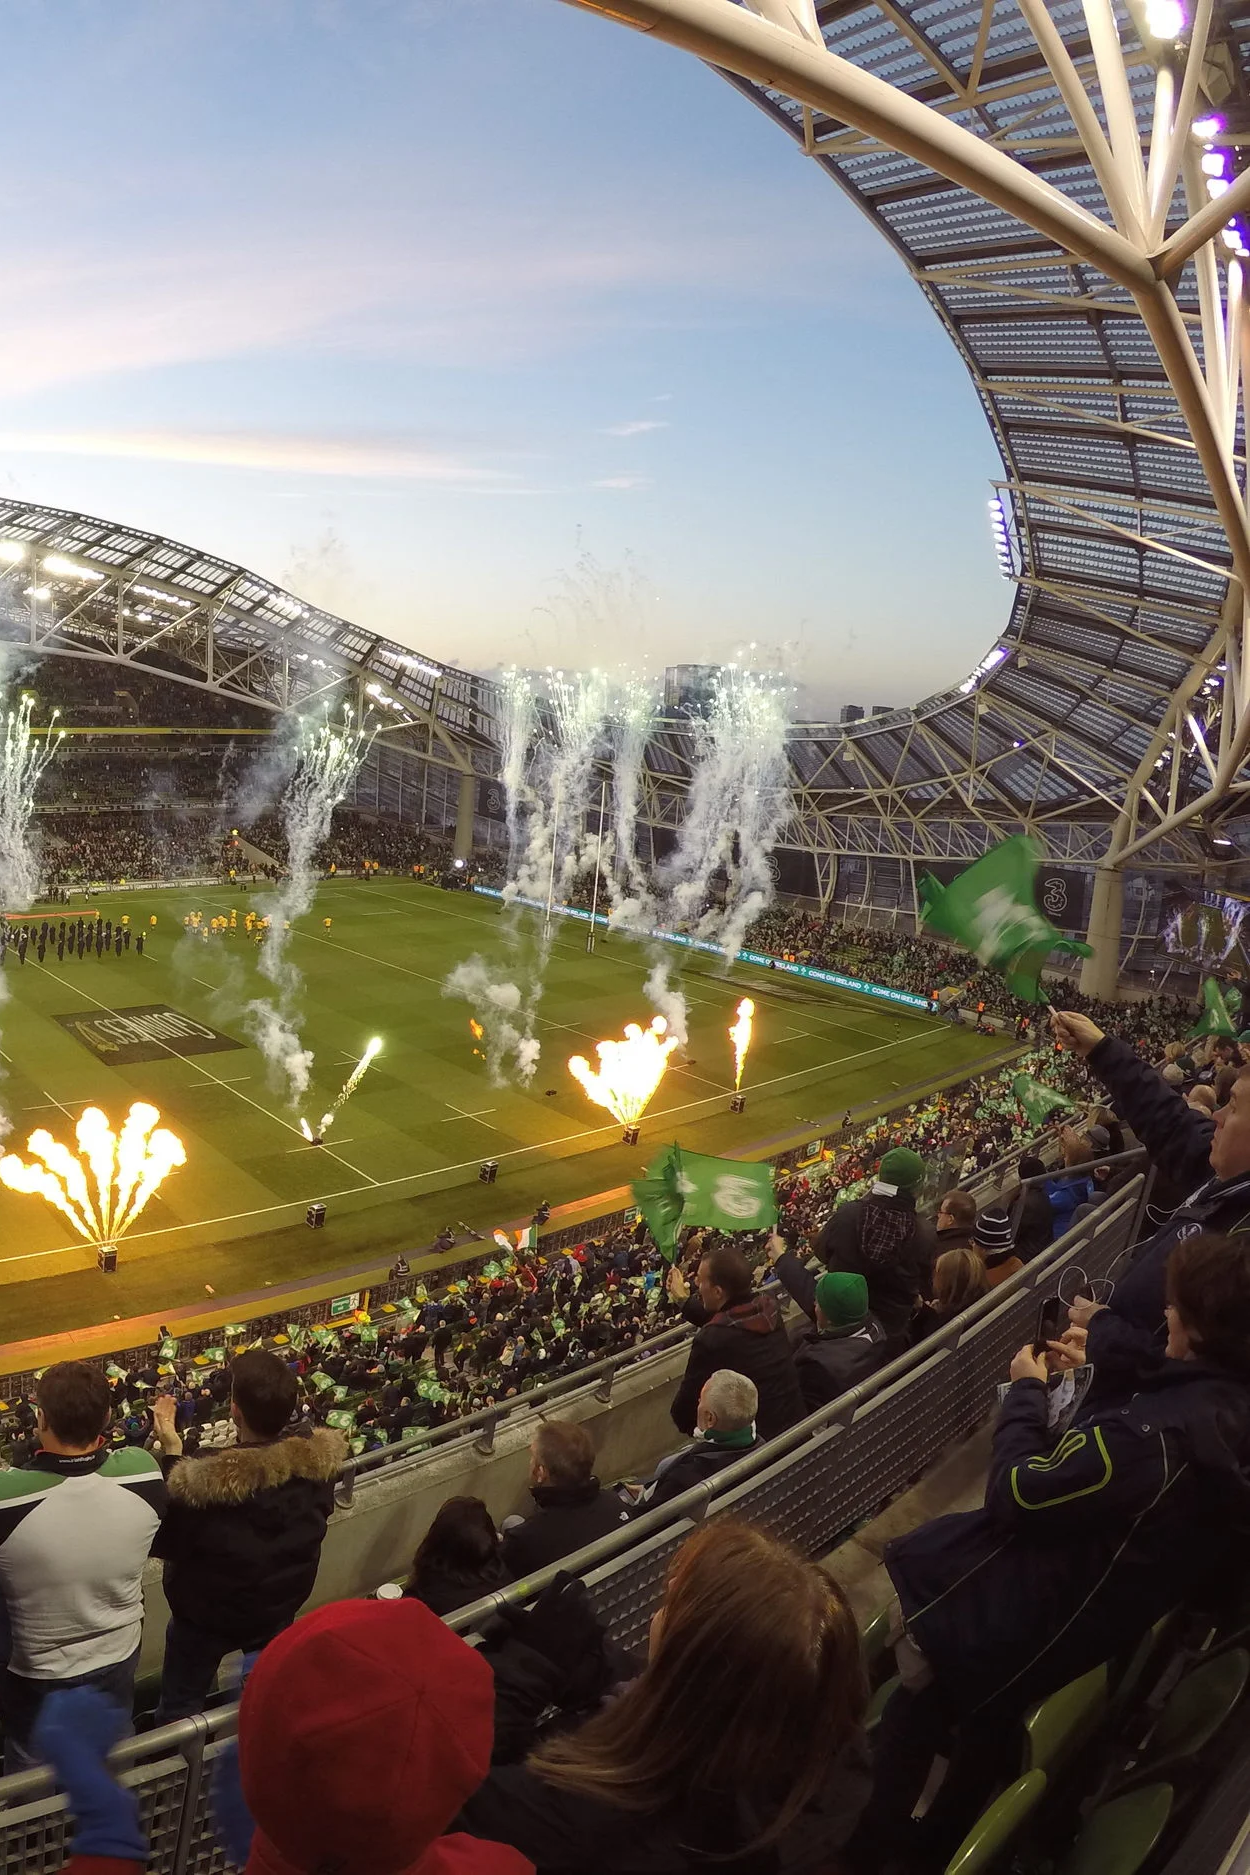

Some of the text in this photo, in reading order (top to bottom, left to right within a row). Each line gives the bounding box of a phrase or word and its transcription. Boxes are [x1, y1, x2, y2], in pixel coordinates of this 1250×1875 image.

[1044, 878, 1067, 911] 3
[749, 954, 766, 964] COME
[808, 970, 862, 989] COME ON IRELAND
[871, 987, 928, 1008] COME ON IRELAND
